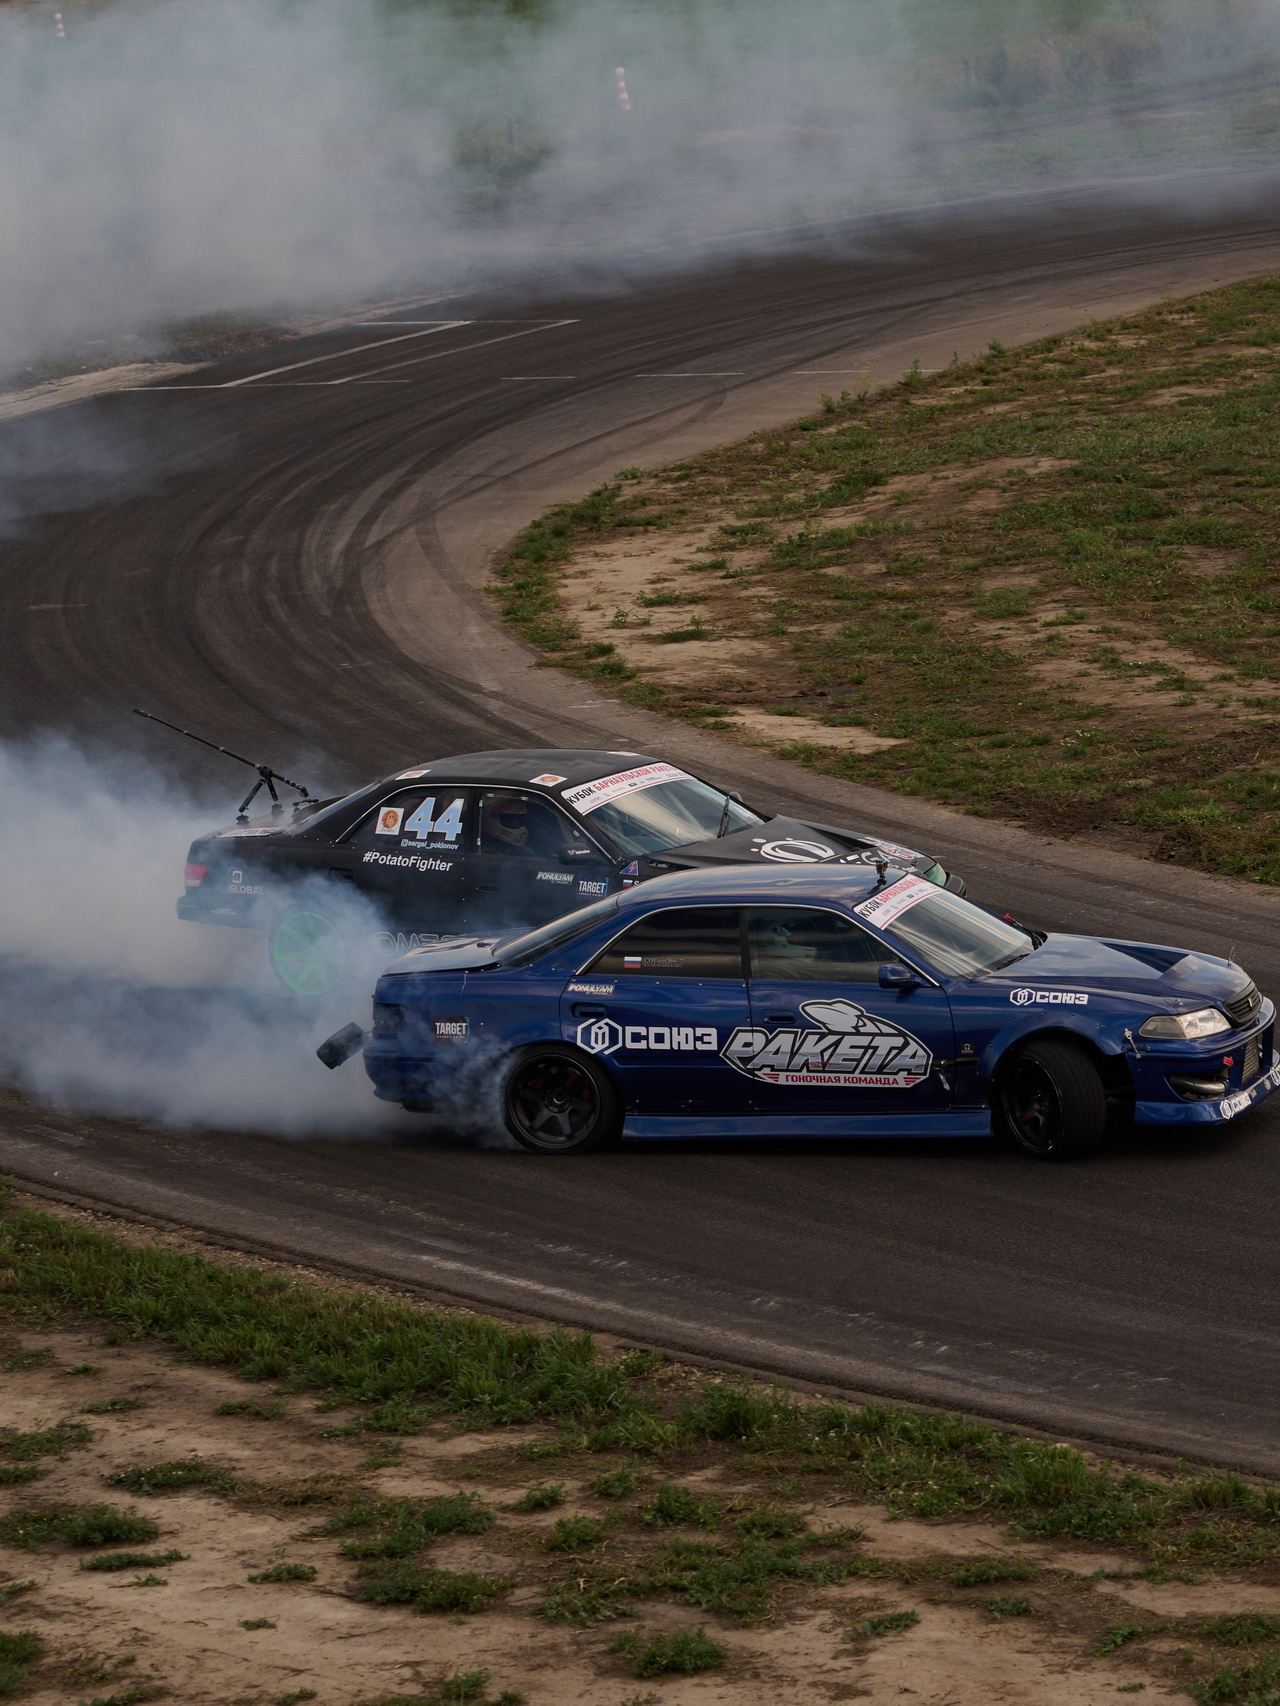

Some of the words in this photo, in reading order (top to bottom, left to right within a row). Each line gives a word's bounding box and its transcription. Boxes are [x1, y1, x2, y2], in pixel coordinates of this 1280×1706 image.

[567, 785, 596, 804] КУБОК
[404, 797, 464, 841] 44
[362, 851, 453, 872] #PotatoFighter
[228, 884, 264, 895] GLOBAL
[579, 880, 606, 894] TARGET
[858, 899, 884, 918] КУБОК
[567, 984, 615, 993] PONULYAM
[1036, 991, 1089, 1005] СОЮЗ
[435, 1022, 467, 1035] TARGET
[625, 1026, 718, 1050] СОЮЗ
[724, 1030, 928, 1074] РАКЕТА
[785, 1074, 841, 1084] ГОНОЧНАЯ
[844, 1075, 899, 1086] КОМАНДА
